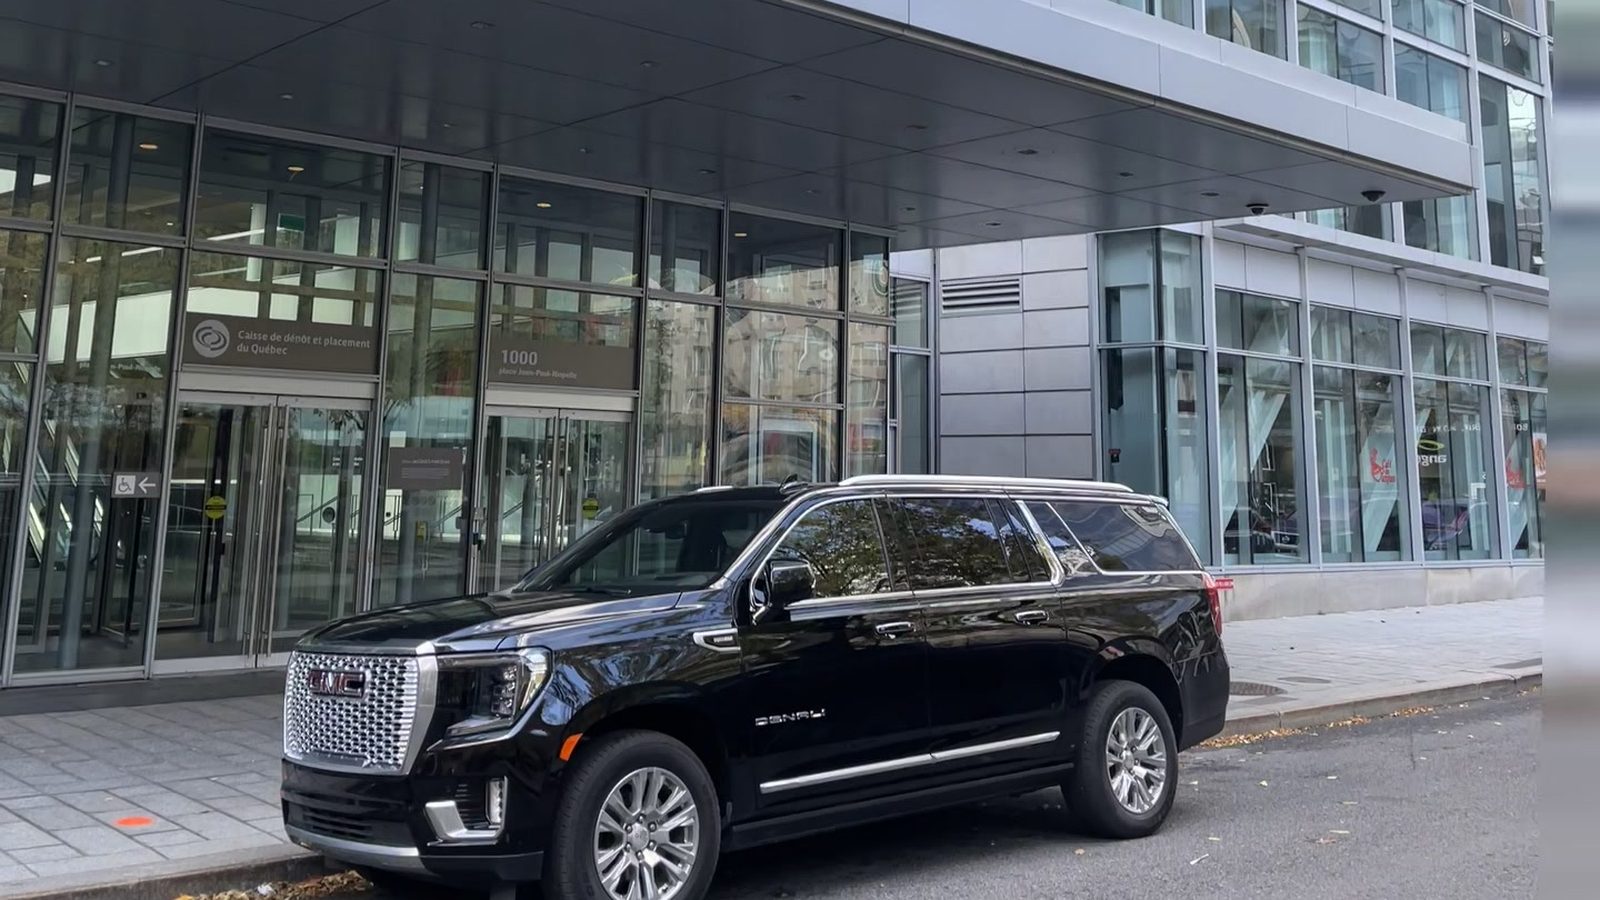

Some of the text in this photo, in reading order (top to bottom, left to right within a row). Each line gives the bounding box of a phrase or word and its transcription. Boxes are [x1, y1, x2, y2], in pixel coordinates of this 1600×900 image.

[238, 330, 370, 349] Caisse de dépôt et placement
[237, 343, 288, 356] du Québec
[501, 349, 538, 365] 1000
[310, 671, 363, 697] GMC
[755, 708, 826, 726] DENALI
